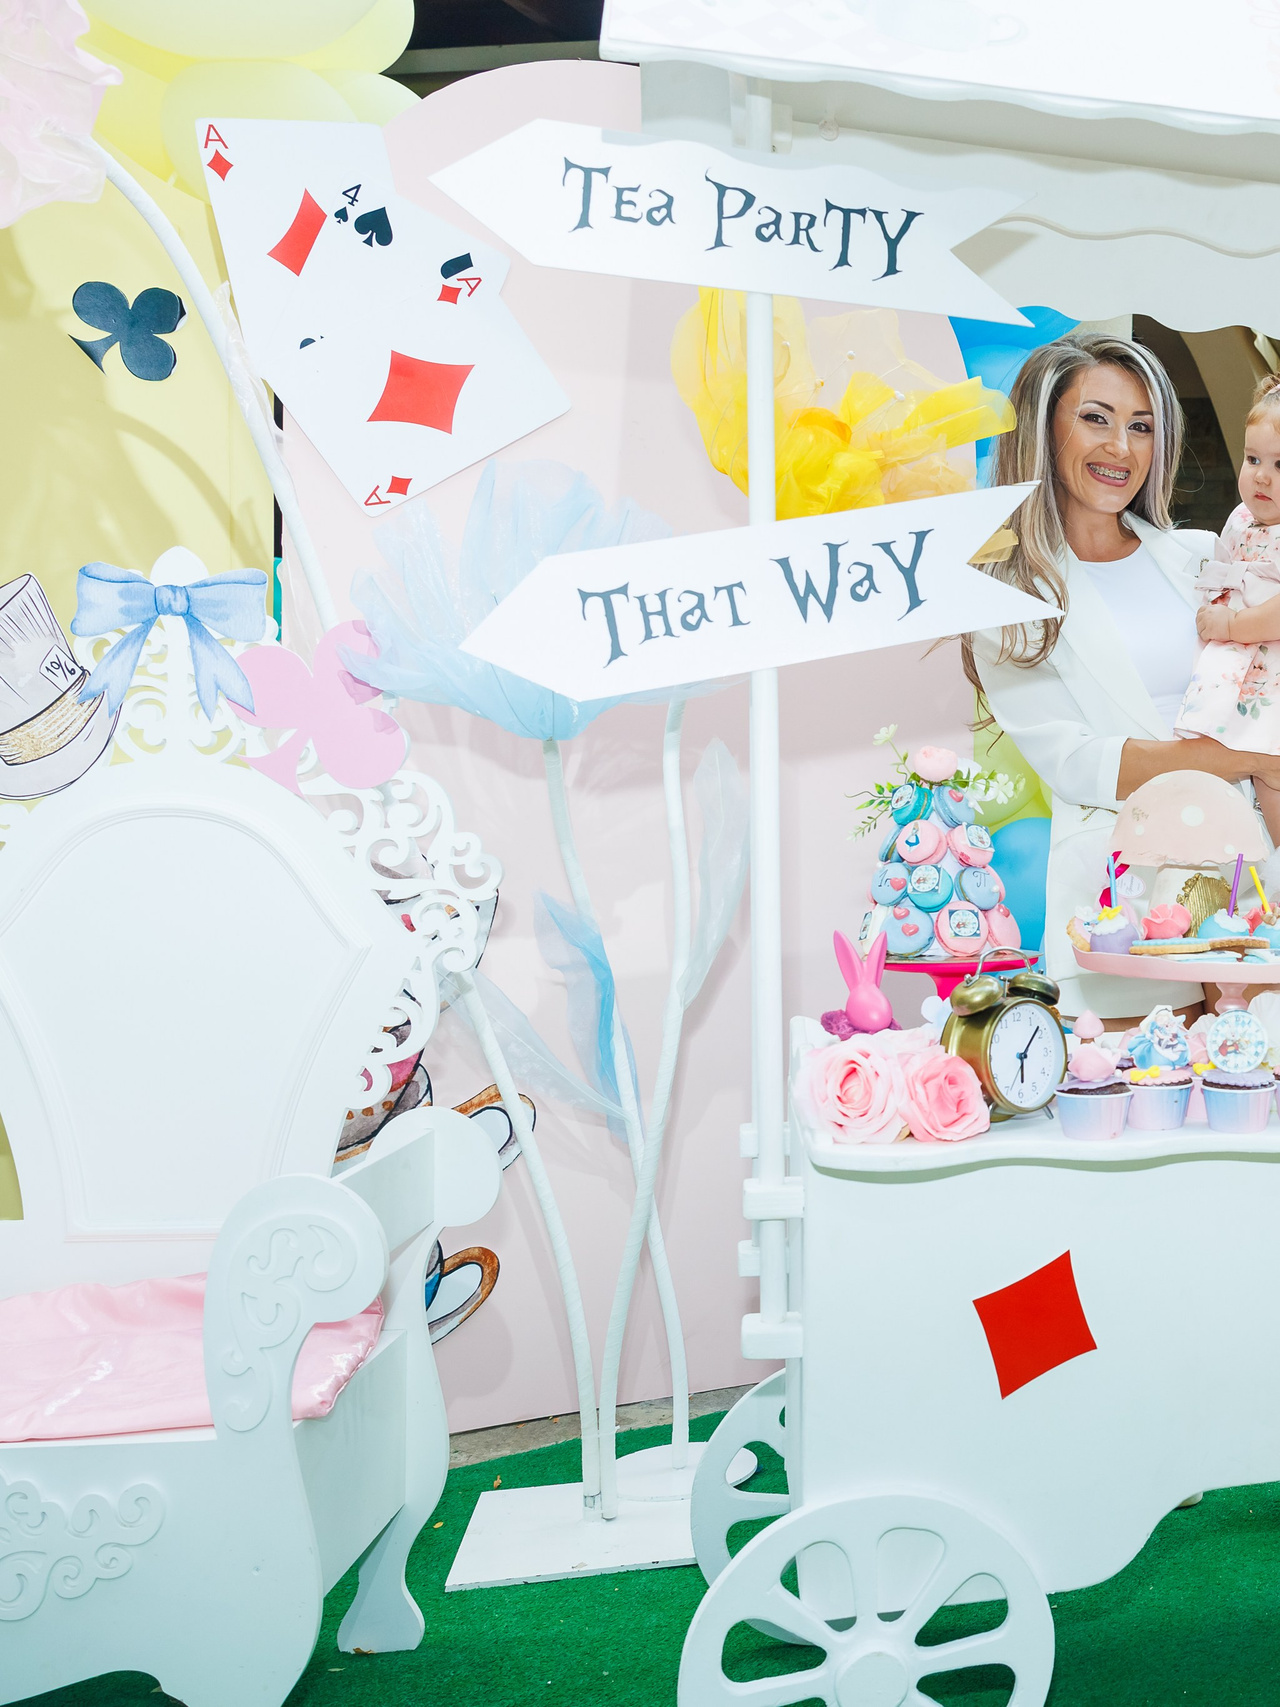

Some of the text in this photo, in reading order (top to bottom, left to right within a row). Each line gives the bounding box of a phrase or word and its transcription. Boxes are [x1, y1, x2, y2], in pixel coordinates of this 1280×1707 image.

[204, 124, 229, 149] A
[342, 184, 362, 206] 4
[457, 277, 482, 297] A
[364, 485, 391, 506] A
[1012, 1012, 1021, 1022] 12
[1038, 1030, 1043, 1039] 2
[1043, 1047, 1049, 1057] 3
[1031, 1082, 1037, 1092] 5
[1018, 1089, 1024, 1099] 6
